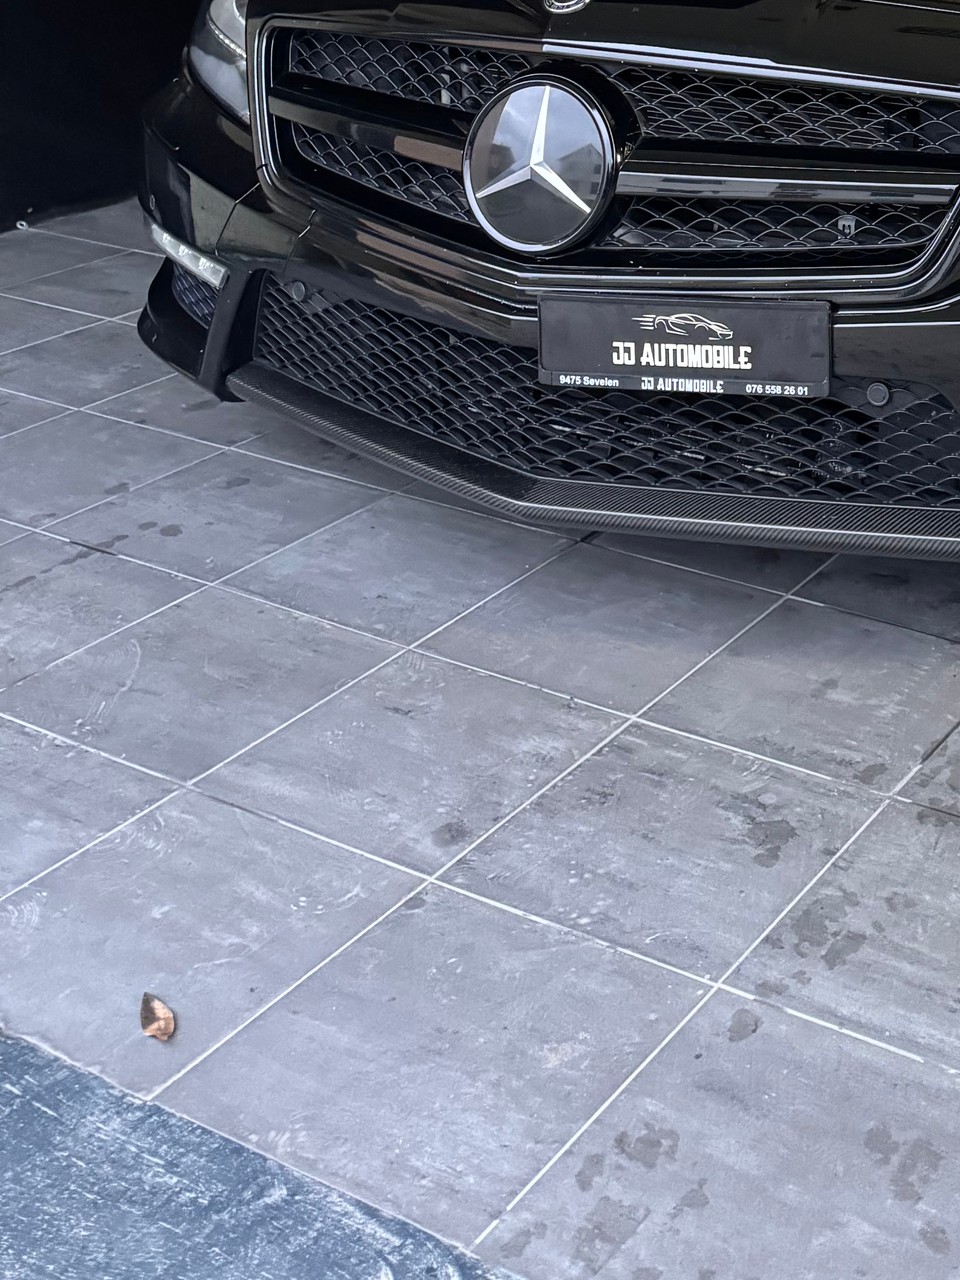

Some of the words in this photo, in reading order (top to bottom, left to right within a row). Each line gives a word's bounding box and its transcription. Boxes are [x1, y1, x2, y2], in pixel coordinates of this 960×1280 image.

[612, 341, 635, 365] JJ
[640, 342, 752, 370] AUTOMOBILE
[559, 374, 581, 385] 9475
[641, 377, 654, 390] JJ
[657, 377, 724, 393] AUTOMOBILE
[745, 384, 763, 394] 076
[764, 384, 782, 395] 558
[783, 386, 796, 395] 26
[797, 386, 809, 396] 01
